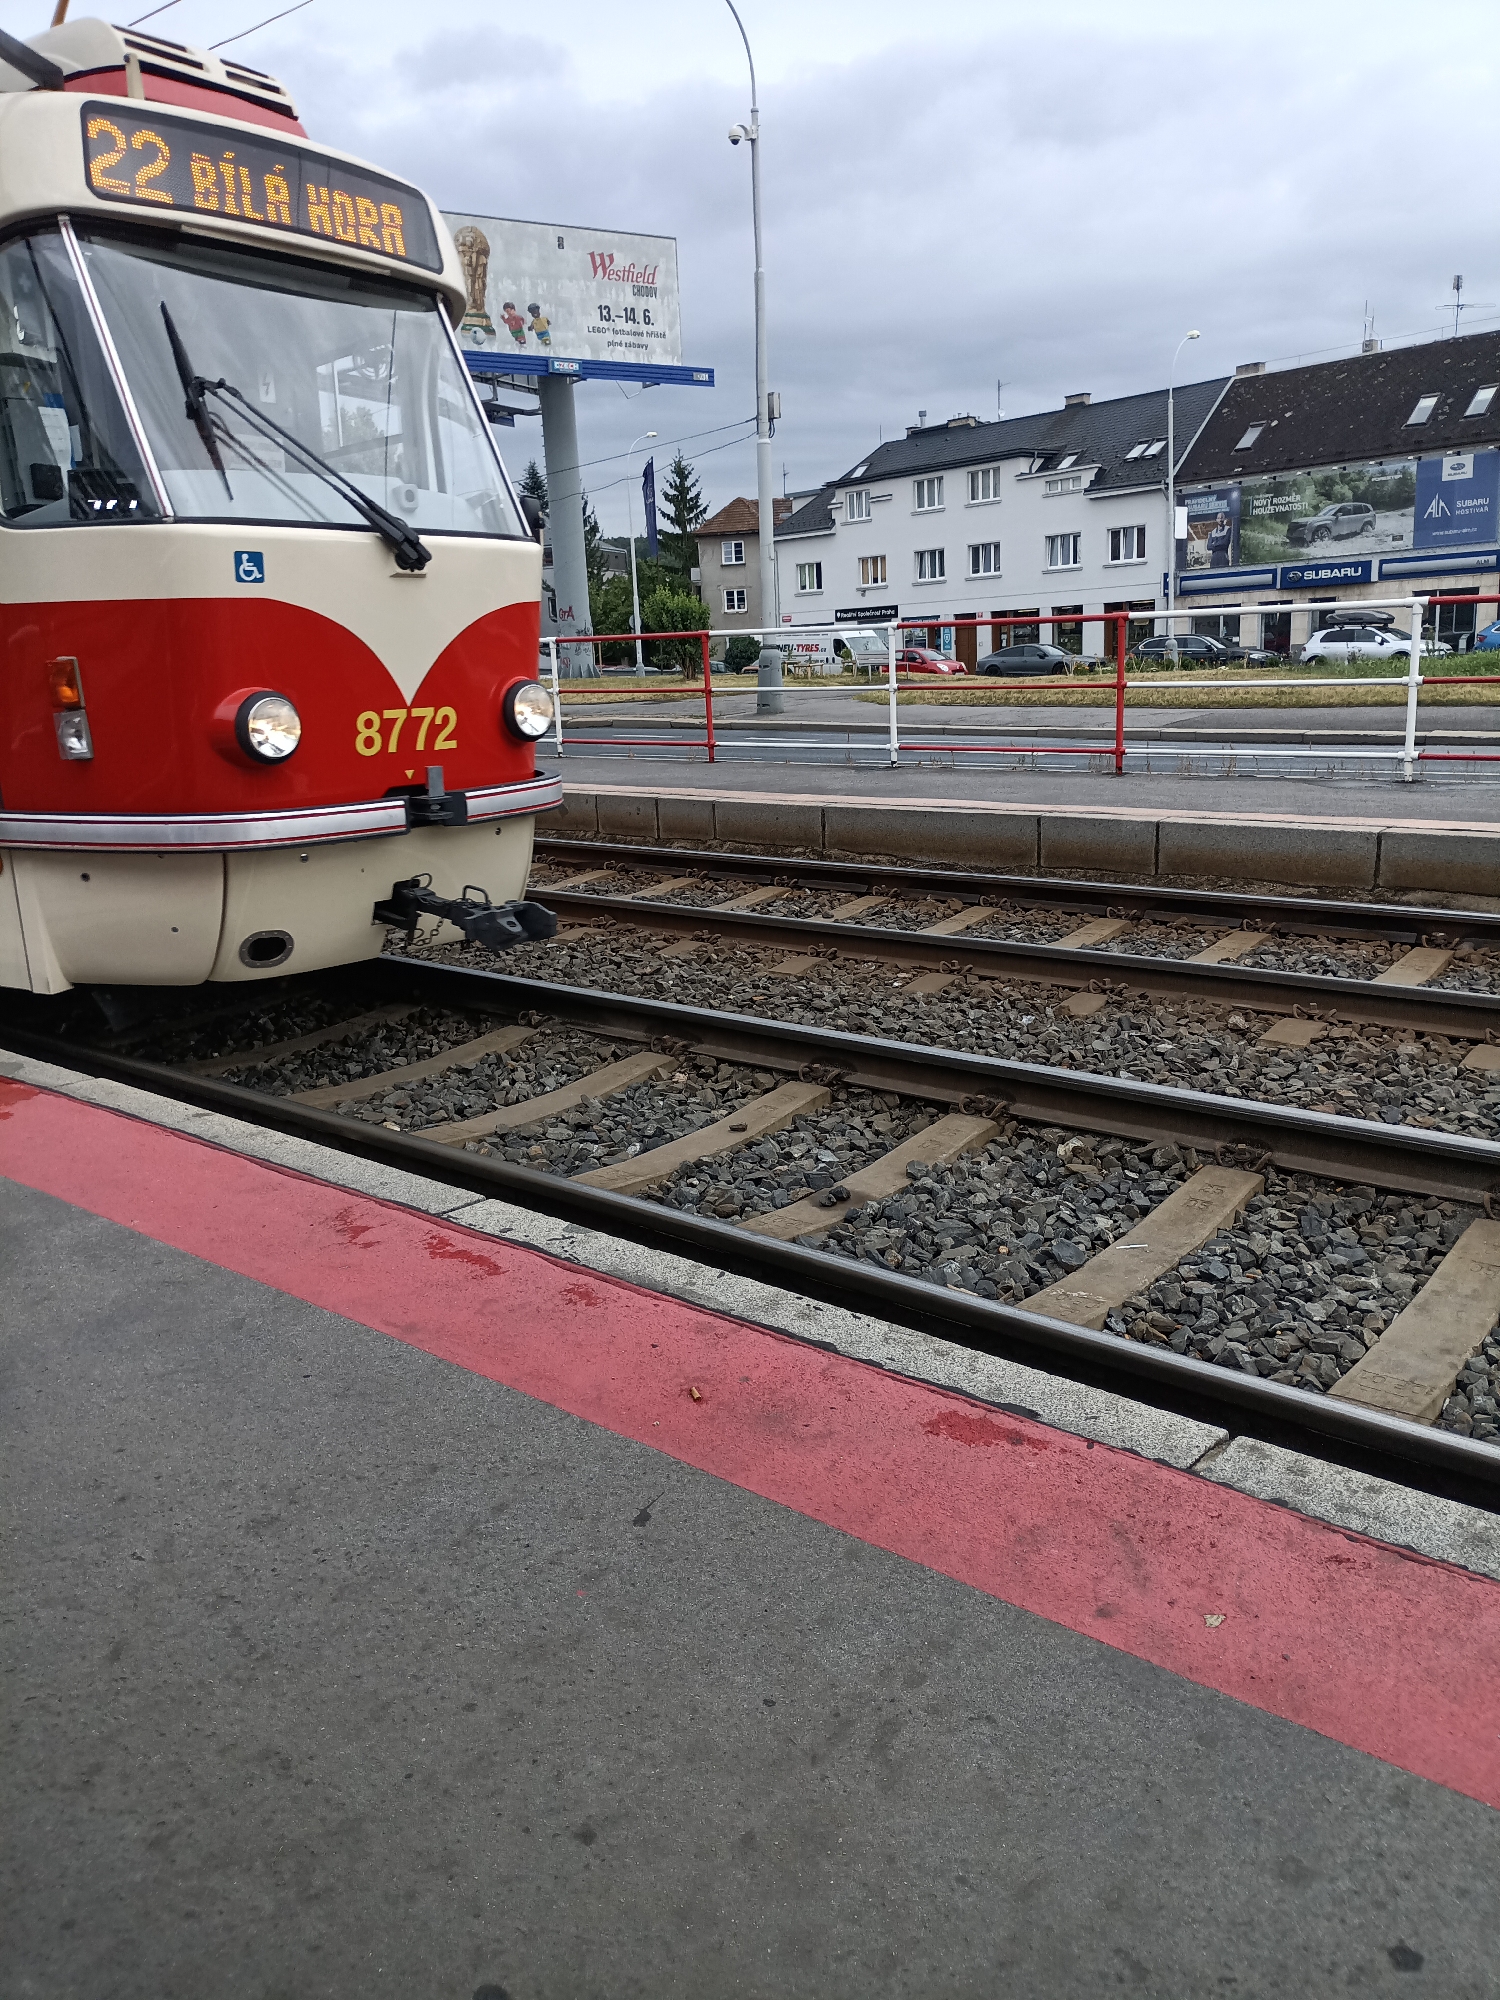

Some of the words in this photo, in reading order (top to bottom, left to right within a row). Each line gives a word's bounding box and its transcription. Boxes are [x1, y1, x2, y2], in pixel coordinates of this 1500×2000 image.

[87, 117, 174, 205] 22
[189, 151, 292, 225] BÍLÁ
[305, 183, 407, 257] HORA
[587, 250, 659, 285] Westfield
[632, 284, 658, 299] CHODOV
[642, 308, 655, 326] 6.
[612, 327, 645, 338] fotbalové
[645, 330, 667, 340] hřiště
[607, 339, 623, 349] plné
[624, 340, 649, 351] zábavy
[1253, 494, 1272, 508] NOVÝ
[1272, 492, 1301, 504] ROZMĚR
[1456, 497, 1490, 508] SUBARU
[1252, 501, 1309, 516] HOUZEVNATOSTI
[1303, 566, 1362, 581] SUBARU
[355, 706, 458, 757] 8772
